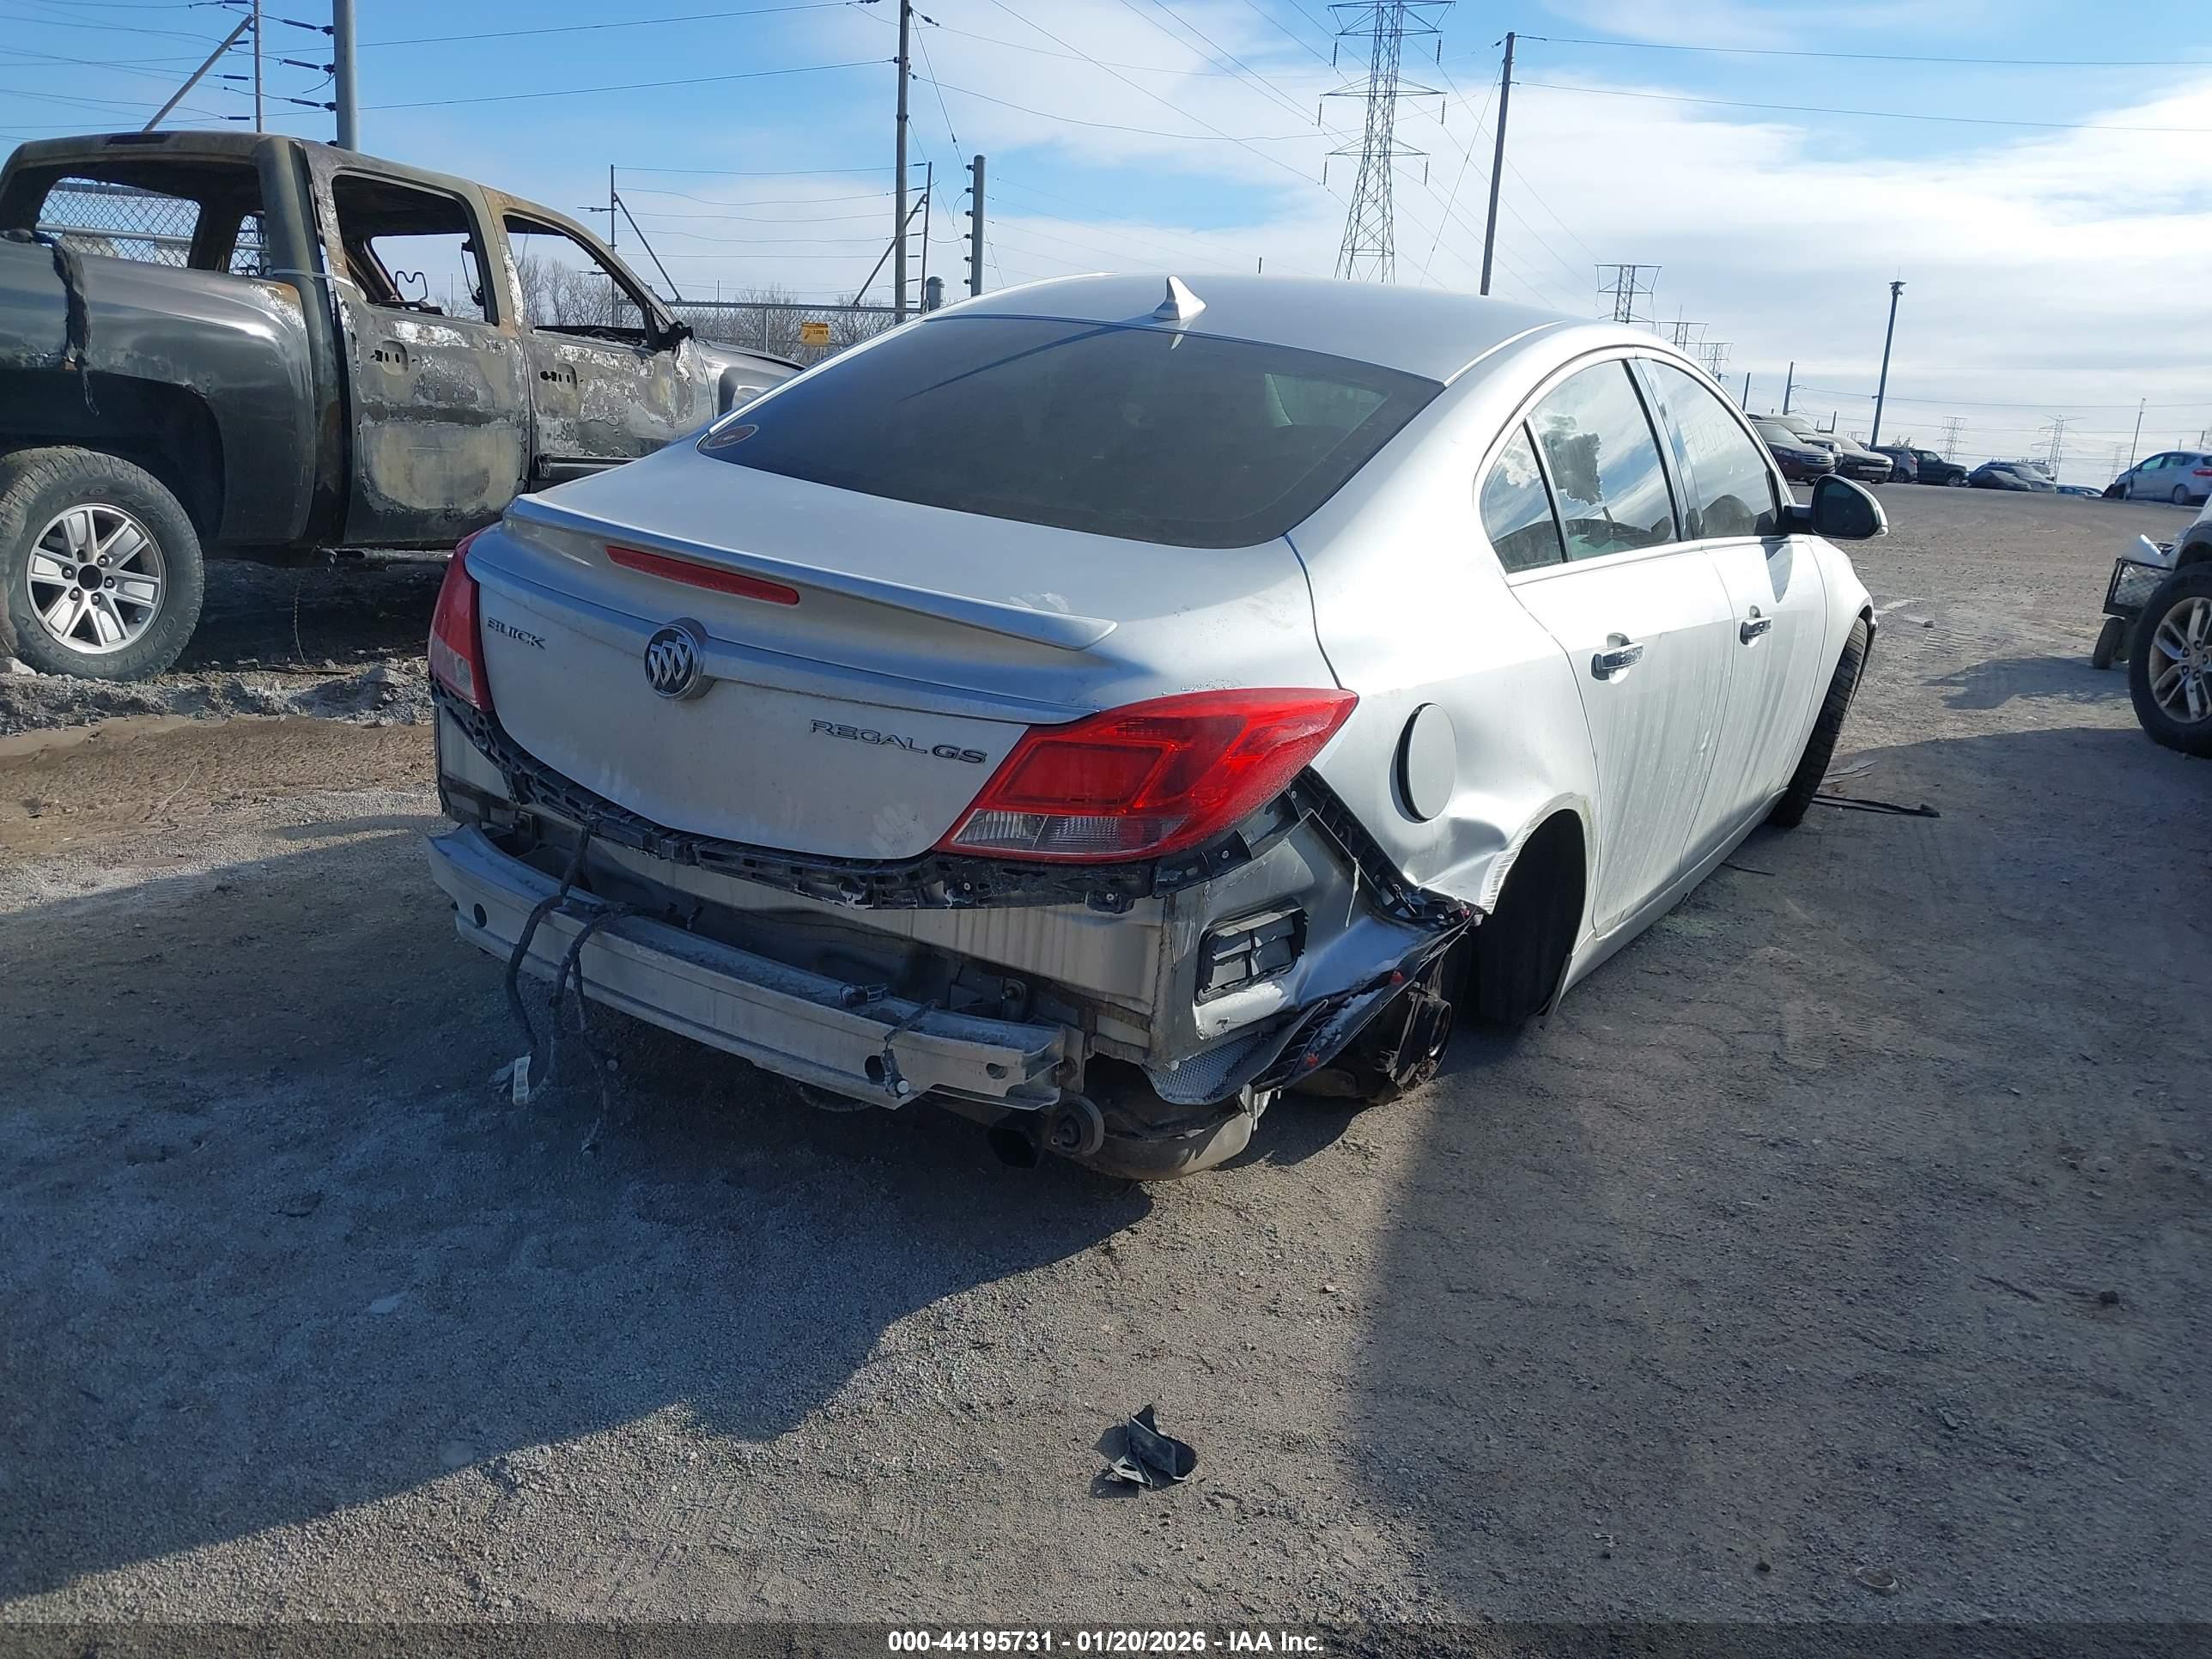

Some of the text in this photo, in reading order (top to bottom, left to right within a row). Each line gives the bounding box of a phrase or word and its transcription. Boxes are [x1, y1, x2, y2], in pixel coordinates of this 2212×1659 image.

[487, 616, 546, 650] BUICK
[811, 719, 988, 764] REGAL GS
